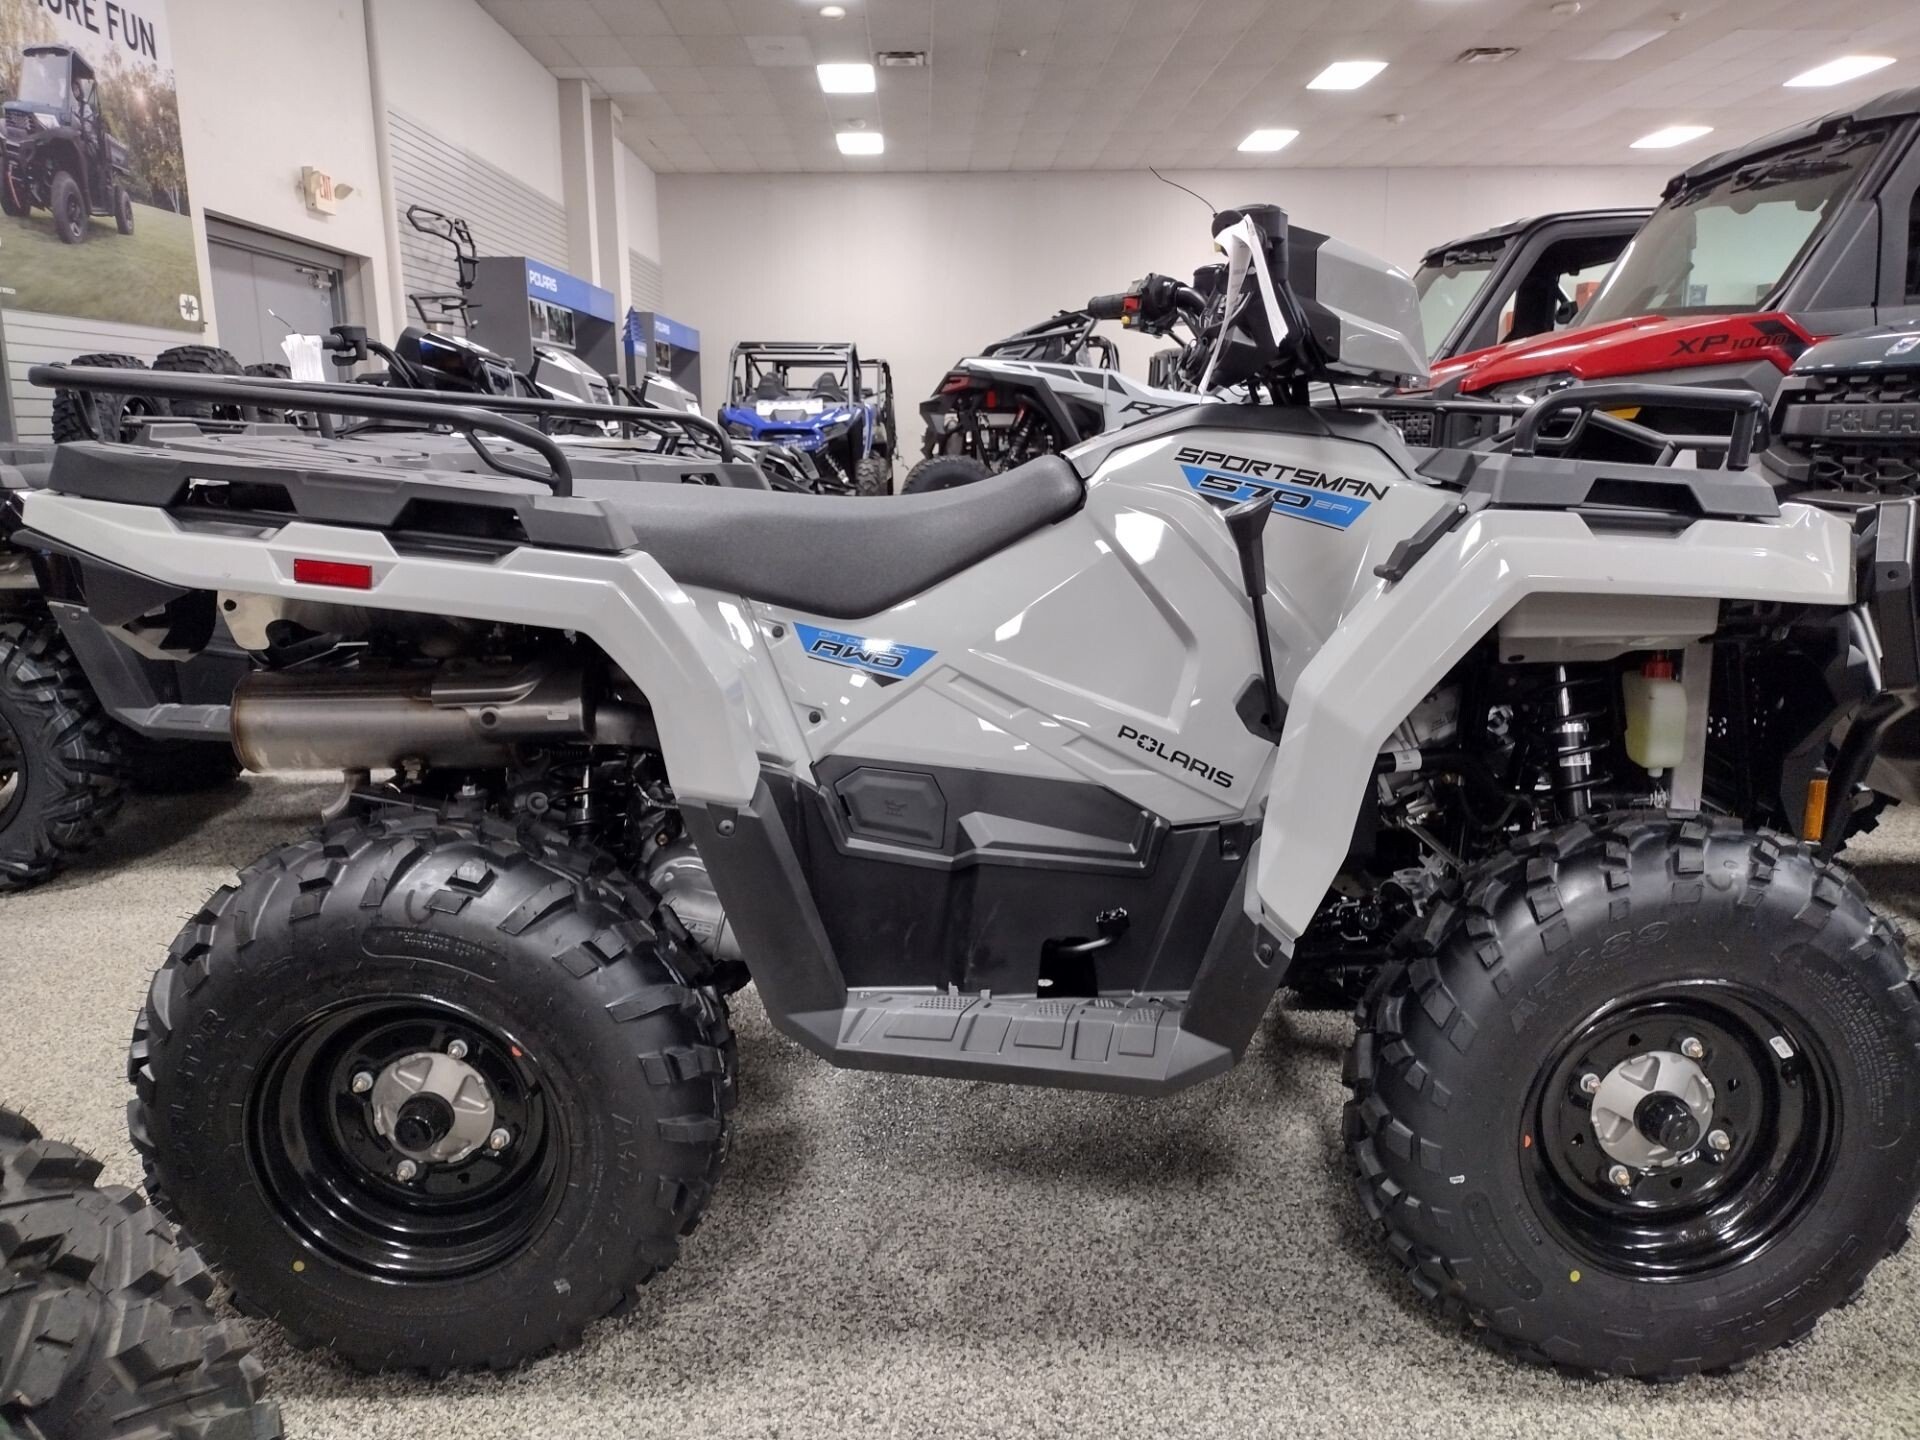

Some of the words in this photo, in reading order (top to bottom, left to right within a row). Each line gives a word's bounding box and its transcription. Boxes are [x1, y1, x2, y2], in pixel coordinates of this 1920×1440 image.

[38, 0, 100, 34] RE
[105, 1, 158, 60] FUN
[529, 270, 557, 293] POLARIS
[1671, 334, 1729, 356] XP
[1731, 333, 1788, 350] 1000
[1825, 409, 1920, 433] POLAR
[1174, 447, 1390, 501] SPORTSMAN
[1199, 474, 1312, 509] 570
[1314, 499, 1352, 515] EFI
[811, 639, 904, 669] AWD
[1117, 724, 1234, 788] POLARIS
